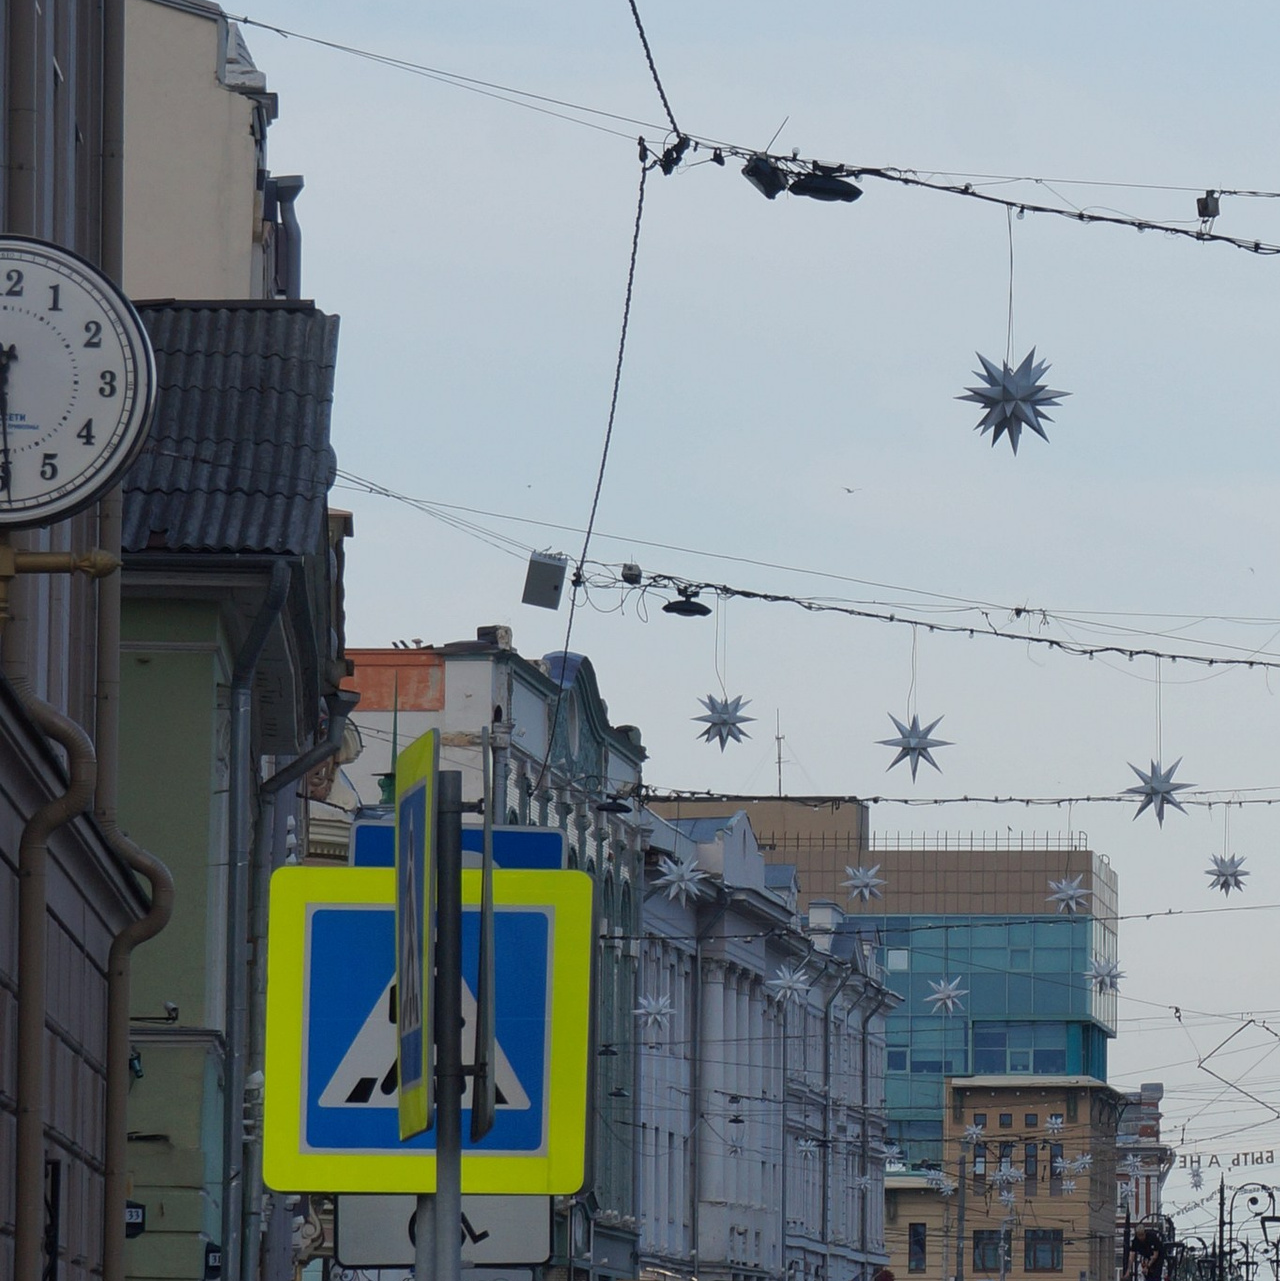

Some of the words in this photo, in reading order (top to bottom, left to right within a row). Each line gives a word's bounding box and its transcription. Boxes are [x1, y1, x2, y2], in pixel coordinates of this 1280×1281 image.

[0, 269, 24, 297] 2
[48, 284, 63, 311] 1
[83, 320, 102, 348] 2
[98, 369, 117, 398] 3
[76, 418, 96, 446] 4
[40, 453, 59, 481] 5
[127, 1210, 140, 1220] 33
